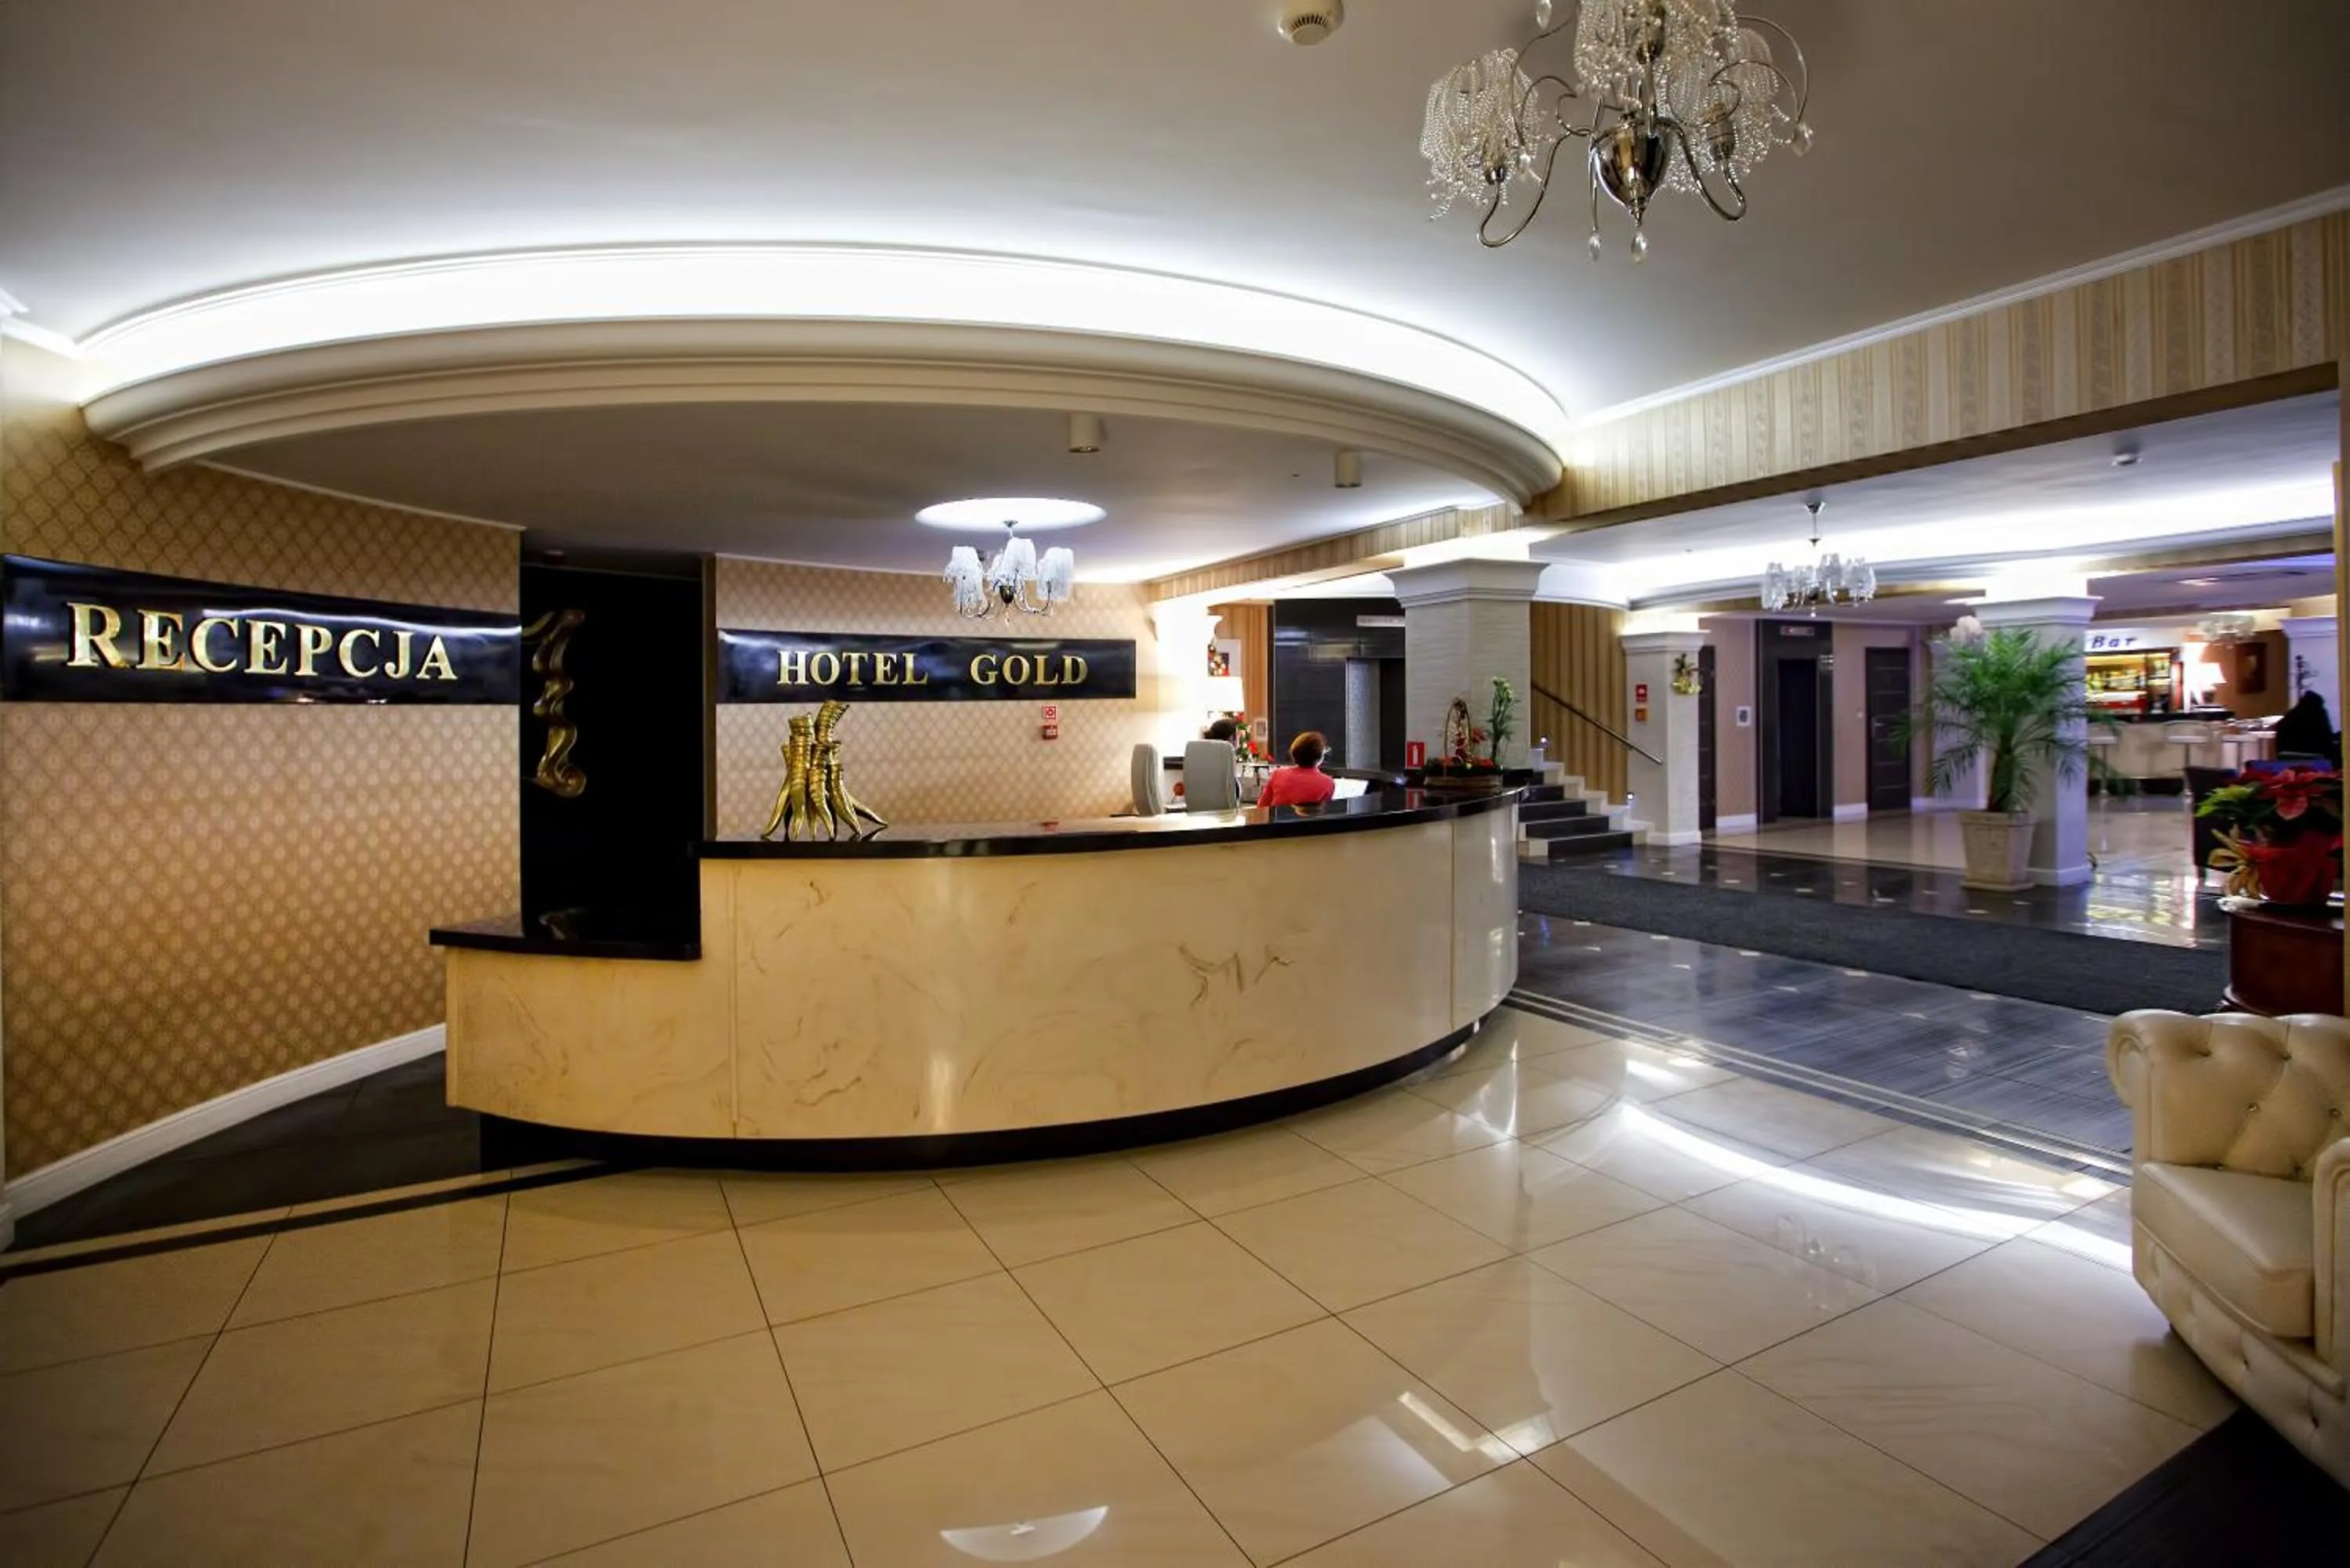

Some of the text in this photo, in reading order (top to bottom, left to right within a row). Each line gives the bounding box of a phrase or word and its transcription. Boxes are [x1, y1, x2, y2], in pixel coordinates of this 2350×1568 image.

[66, 602, 458, 681] RECEPCJA
[2092, 635, 2137, 649] Bar
[776, 649, 1089, 686] HOTEL GOLD
